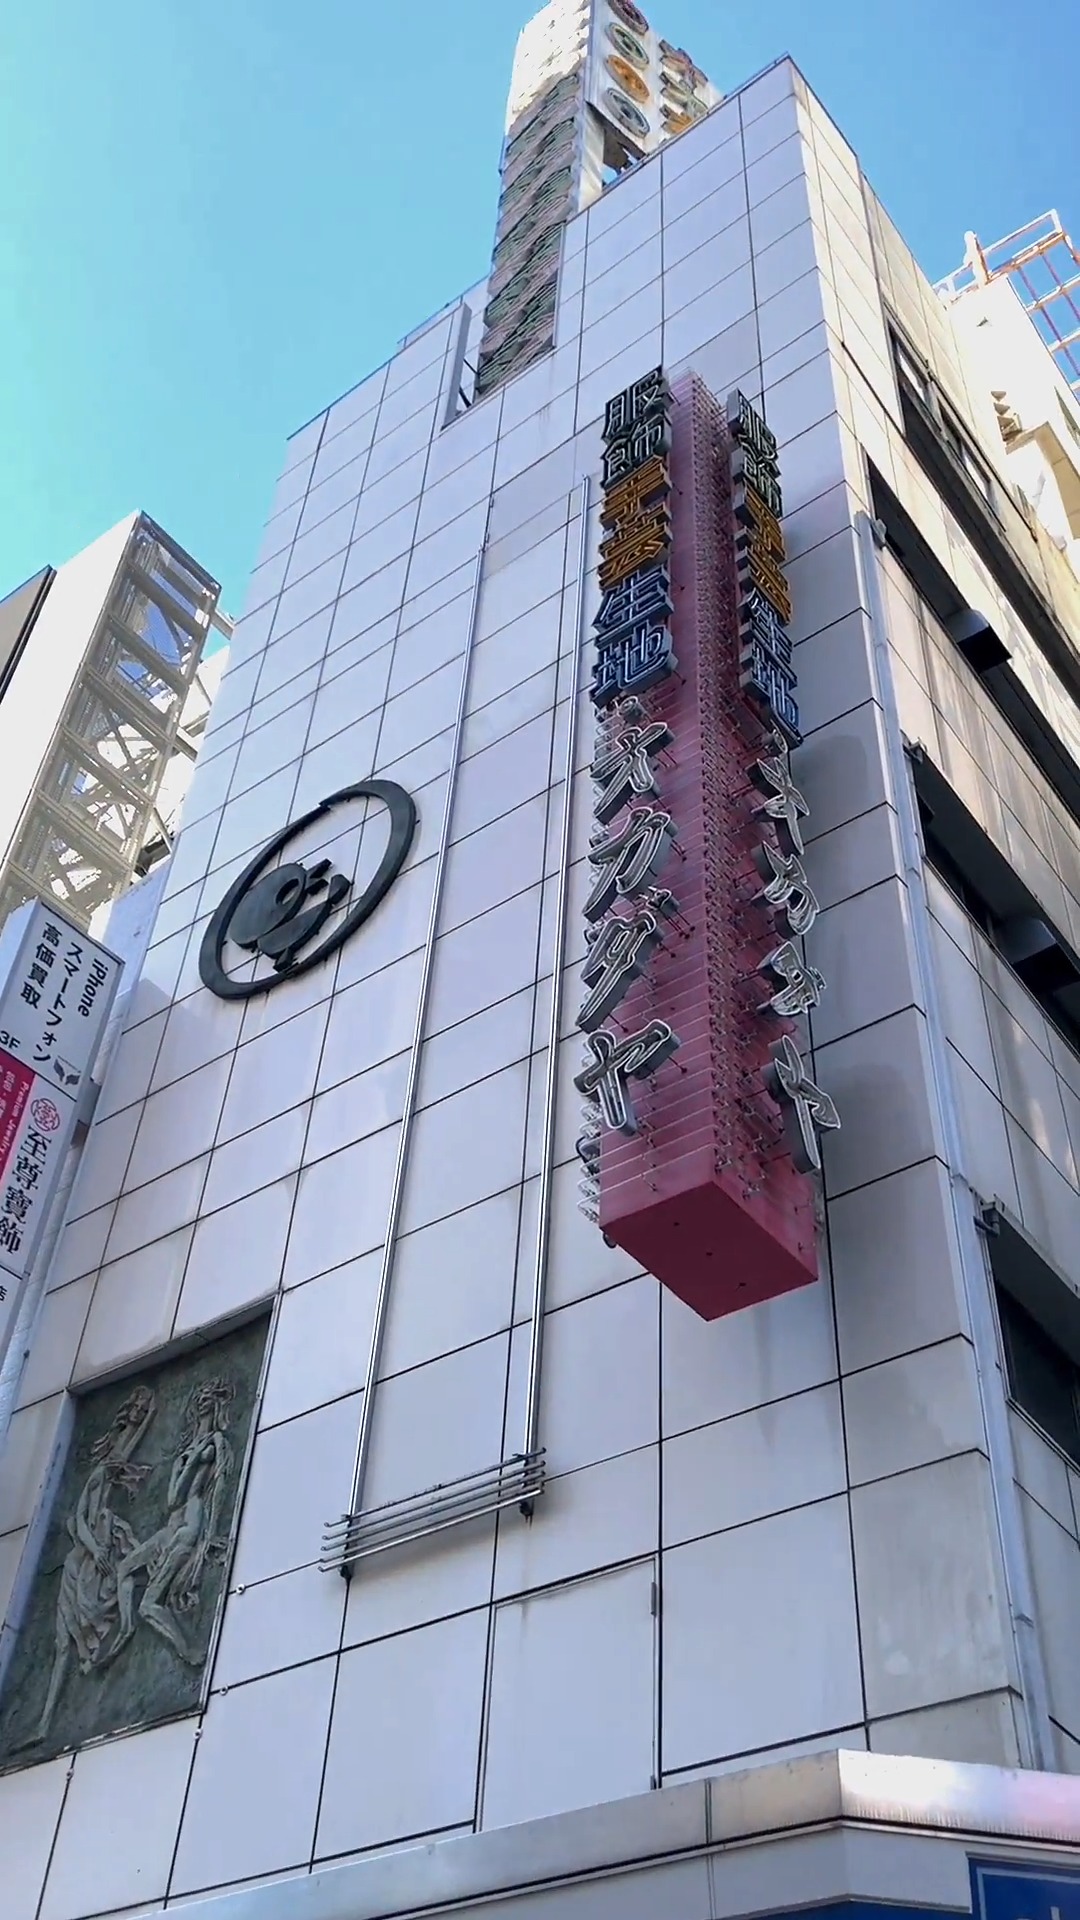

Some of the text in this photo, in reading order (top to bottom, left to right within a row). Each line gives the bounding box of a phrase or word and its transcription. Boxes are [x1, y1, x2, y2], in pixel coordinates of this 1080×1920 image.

[20, 922, 63, 1009] 高価買取
[33, 942, 84, 1062] スマートフォン
[78, 958, 109, 1017] iPhone
[0, 1031, 20, 1050] 3F
